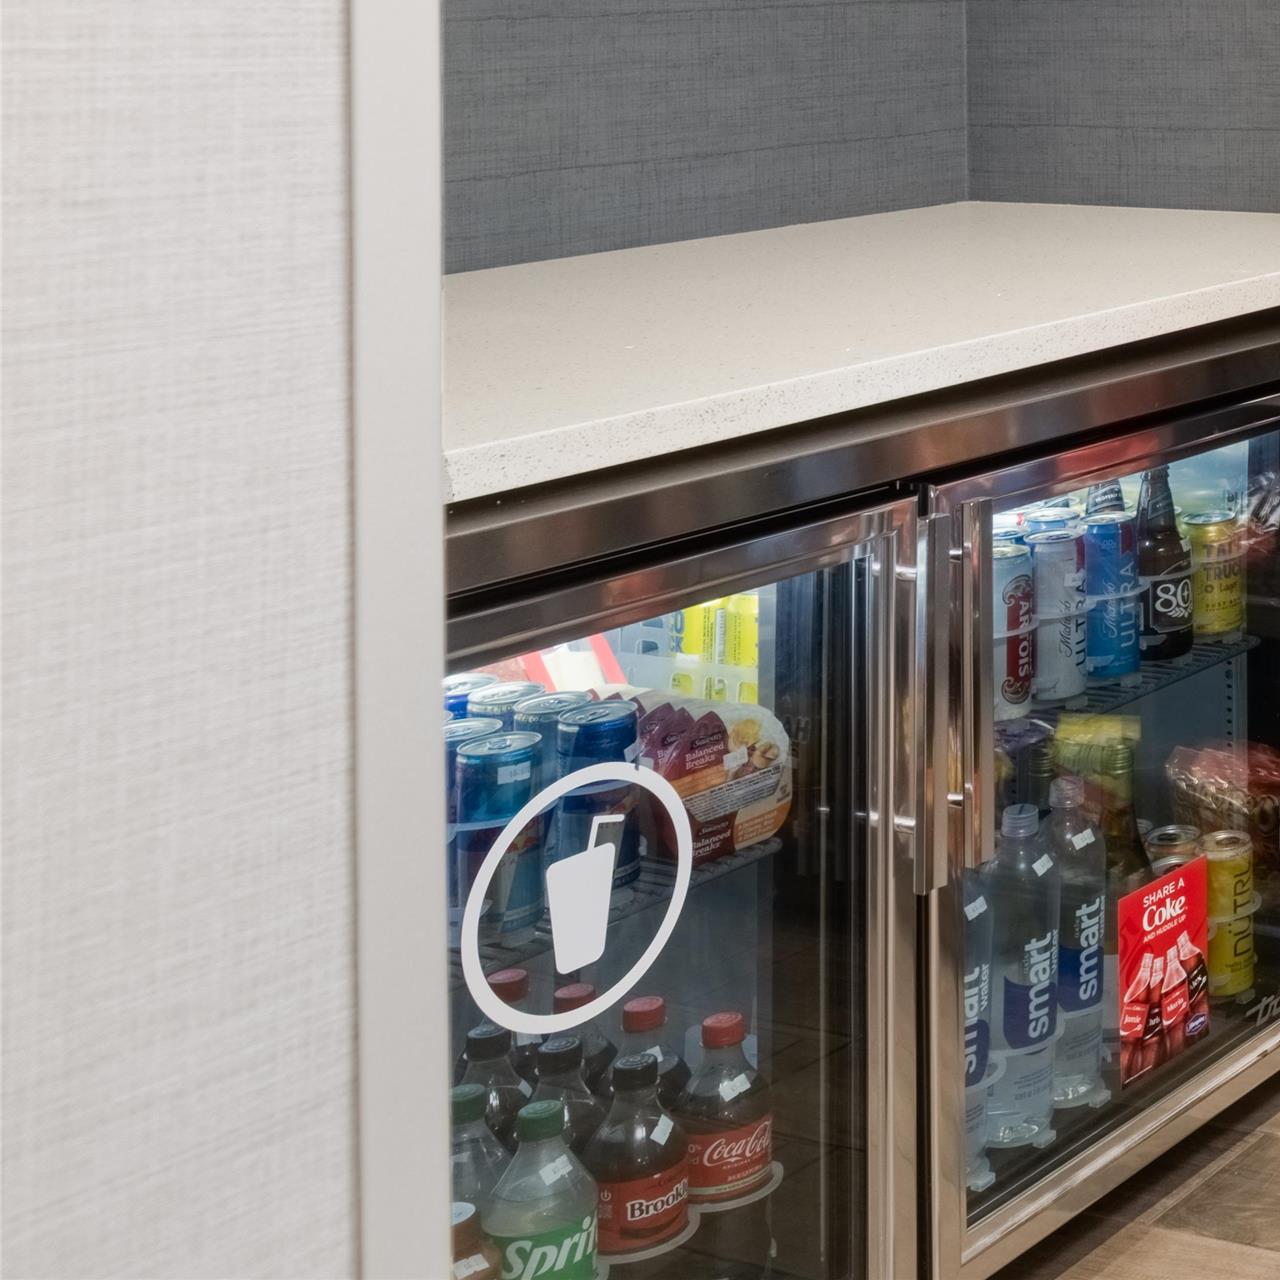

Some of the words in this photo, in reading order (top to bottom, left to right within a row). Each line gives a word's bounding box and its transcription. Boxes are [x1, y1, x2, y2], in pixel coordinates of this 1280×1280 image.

[1120, 561, 1136, 650] ULTRA
[684, 741, 725, 762] Balanced
[685, 753, 717, 770] Breaks
[1142, 885, 1176, 908] SHARE
[1177, 877, 1185, 890] A
[1142, 894, 1187, 932] Coke
[1143, 930, 1156, 943] AND
[1156, 919, 1178, 937] HUDDLE
[1178, 914, 1187, 925] UP
[1075, 896, 1101, 1002] smart
[980, 963, 990, 1012] water
[1024, 931, 1052, 1039] smart
